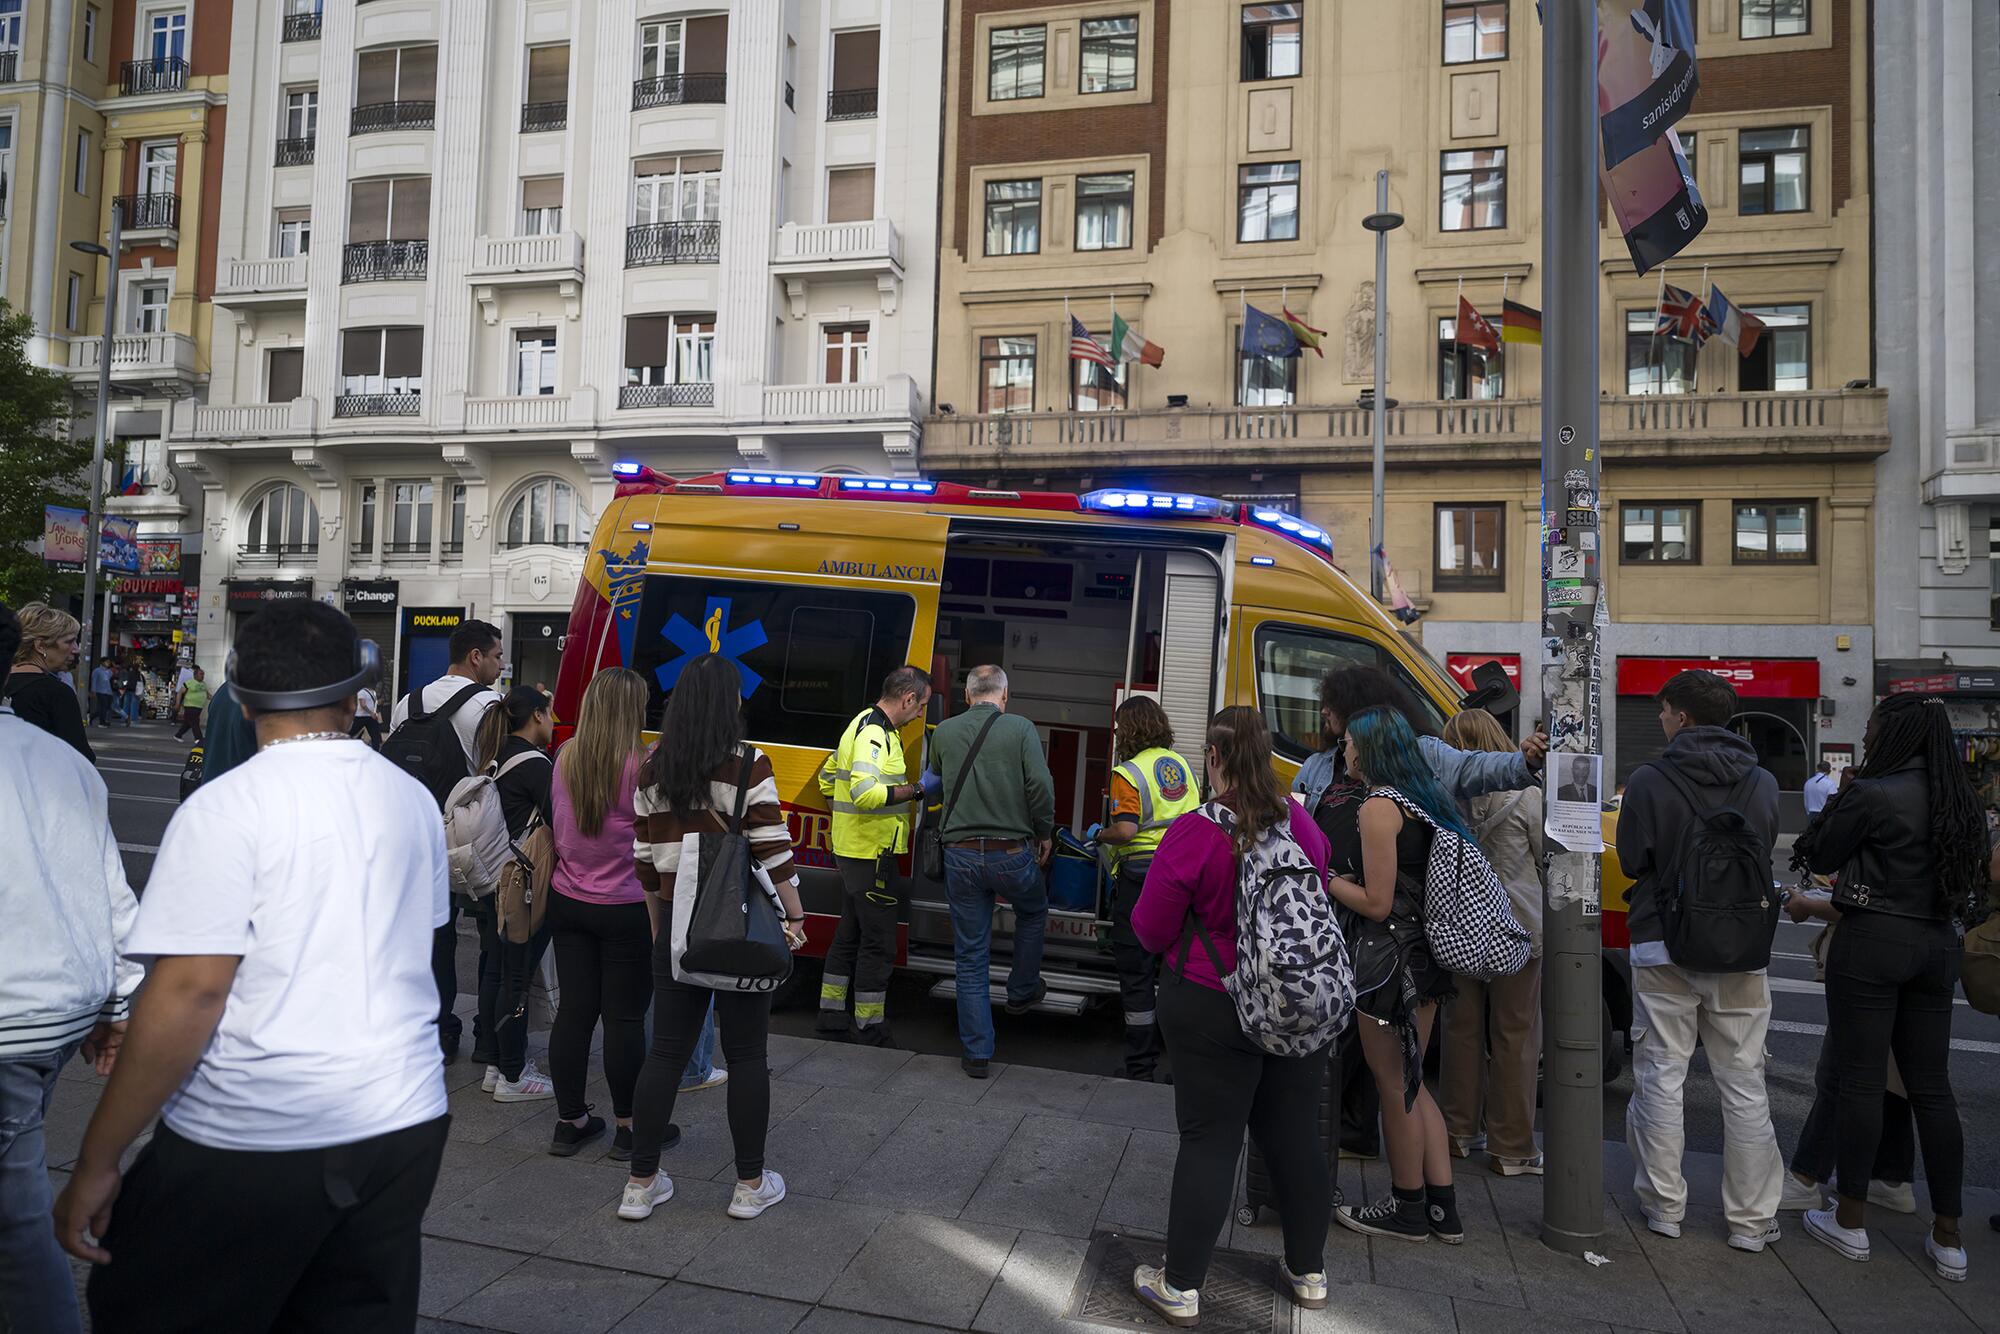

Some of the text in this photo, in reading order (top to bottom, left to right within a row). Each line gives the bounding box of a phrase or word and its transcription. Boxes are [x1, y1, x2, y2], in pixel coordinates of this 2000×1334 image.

[48, 521, 66, 534] SAN
[55, 531, 85, 549] ISIDRO
[818, 560, 938, 581] AMBULANCIA
[356, 590, 396, 603] Change
[413, 615, 460, 626] DUCKLAND
[1450, 664, 1518, 676] VS
[1681, 669, 1754, 680] PS
